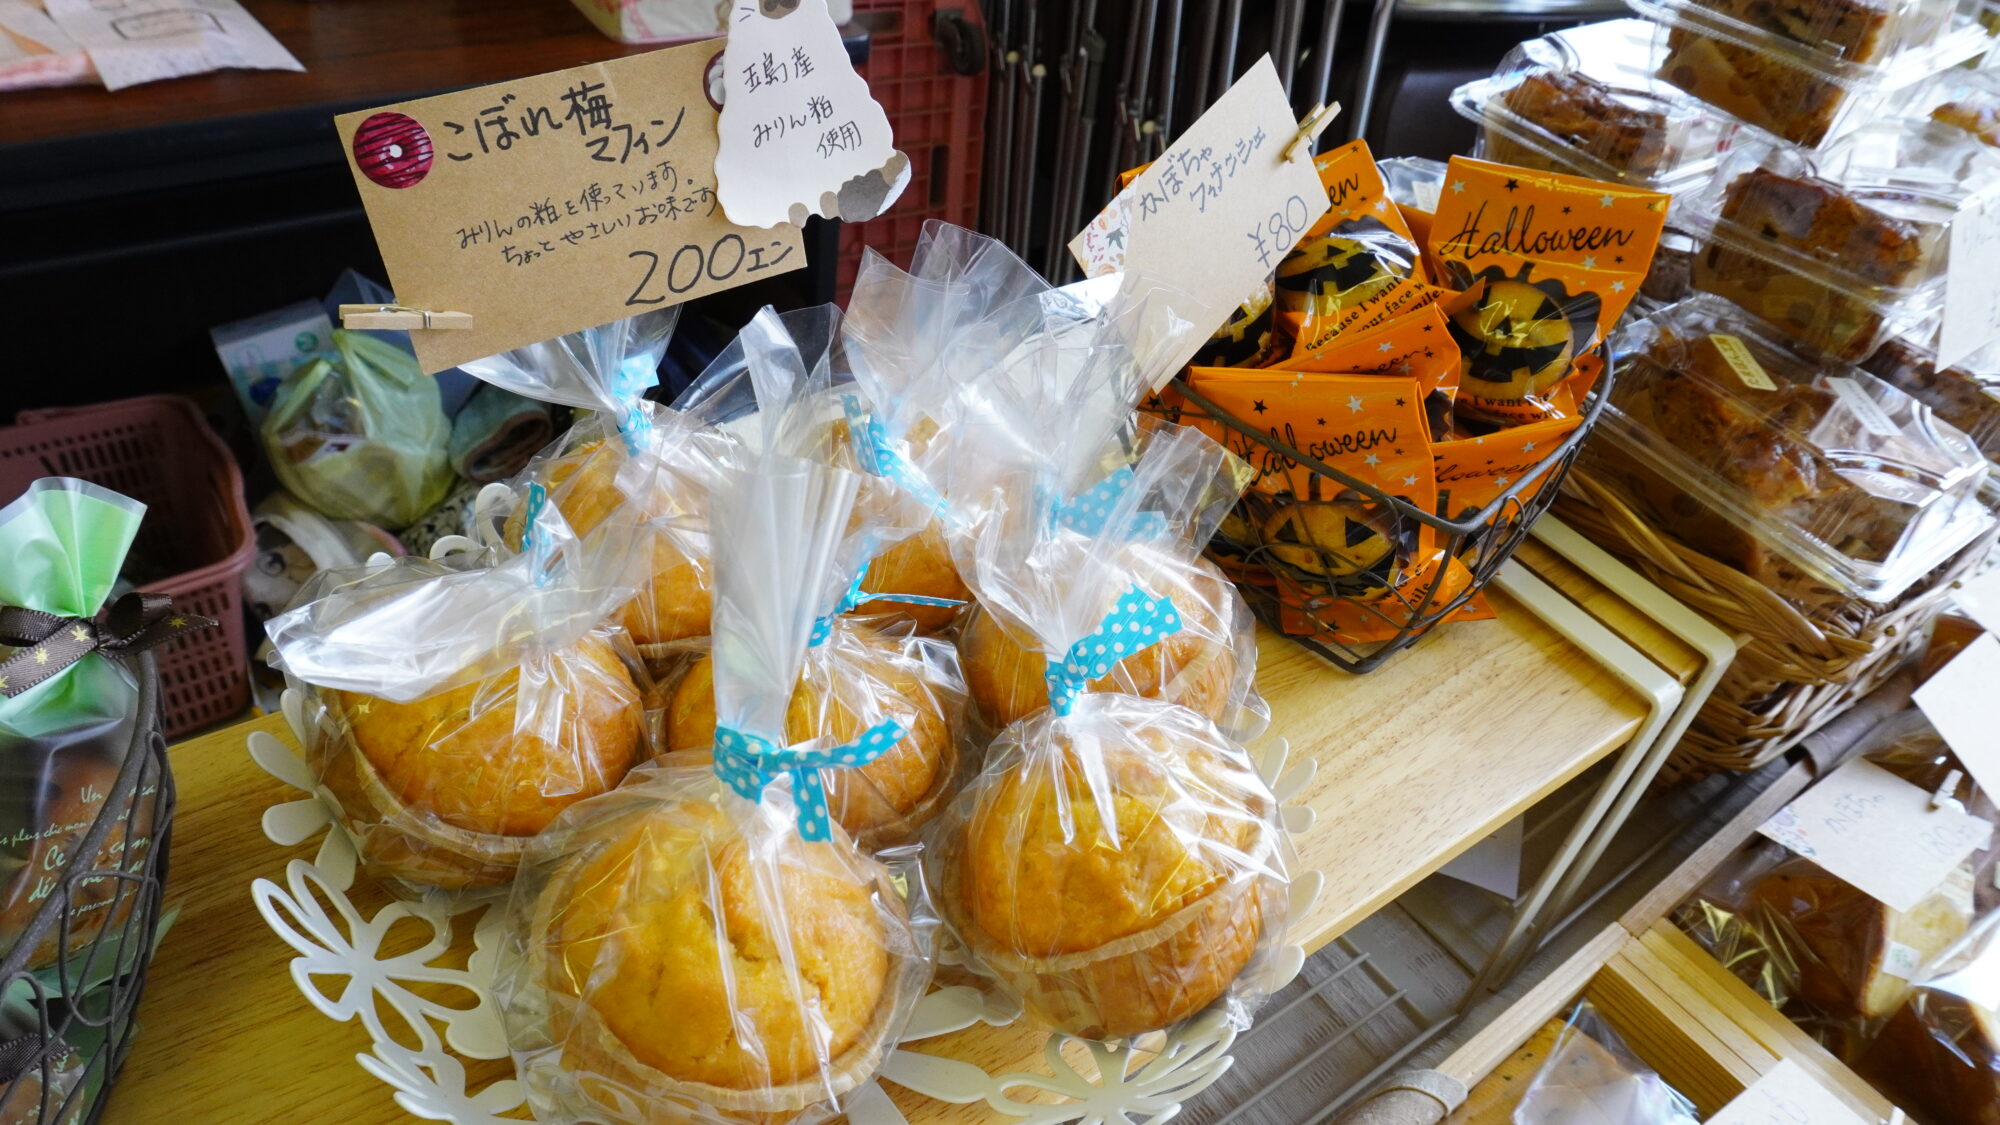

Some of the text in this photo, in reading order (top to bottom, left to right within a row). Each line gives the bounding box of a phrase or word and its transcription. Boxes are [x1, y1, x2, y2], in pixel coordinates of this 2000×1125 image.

[443, 81, 613, 161] こぼれ梅
[585, 106, 685, 163] マフィン
[752, 95, 834, 148] みりん粕
[816, 120, 862, 159] 使用
[1138, 145, 1213, 221] かぼちゃ
[1247, 195, 1308, 268] ¥80
[1438, 200, 1635, 260] Halloween
[1369, 276, 1402, 306] want
[1384, 289, 1413, 315] face
[1406, 289, 1445, 314] mile.
